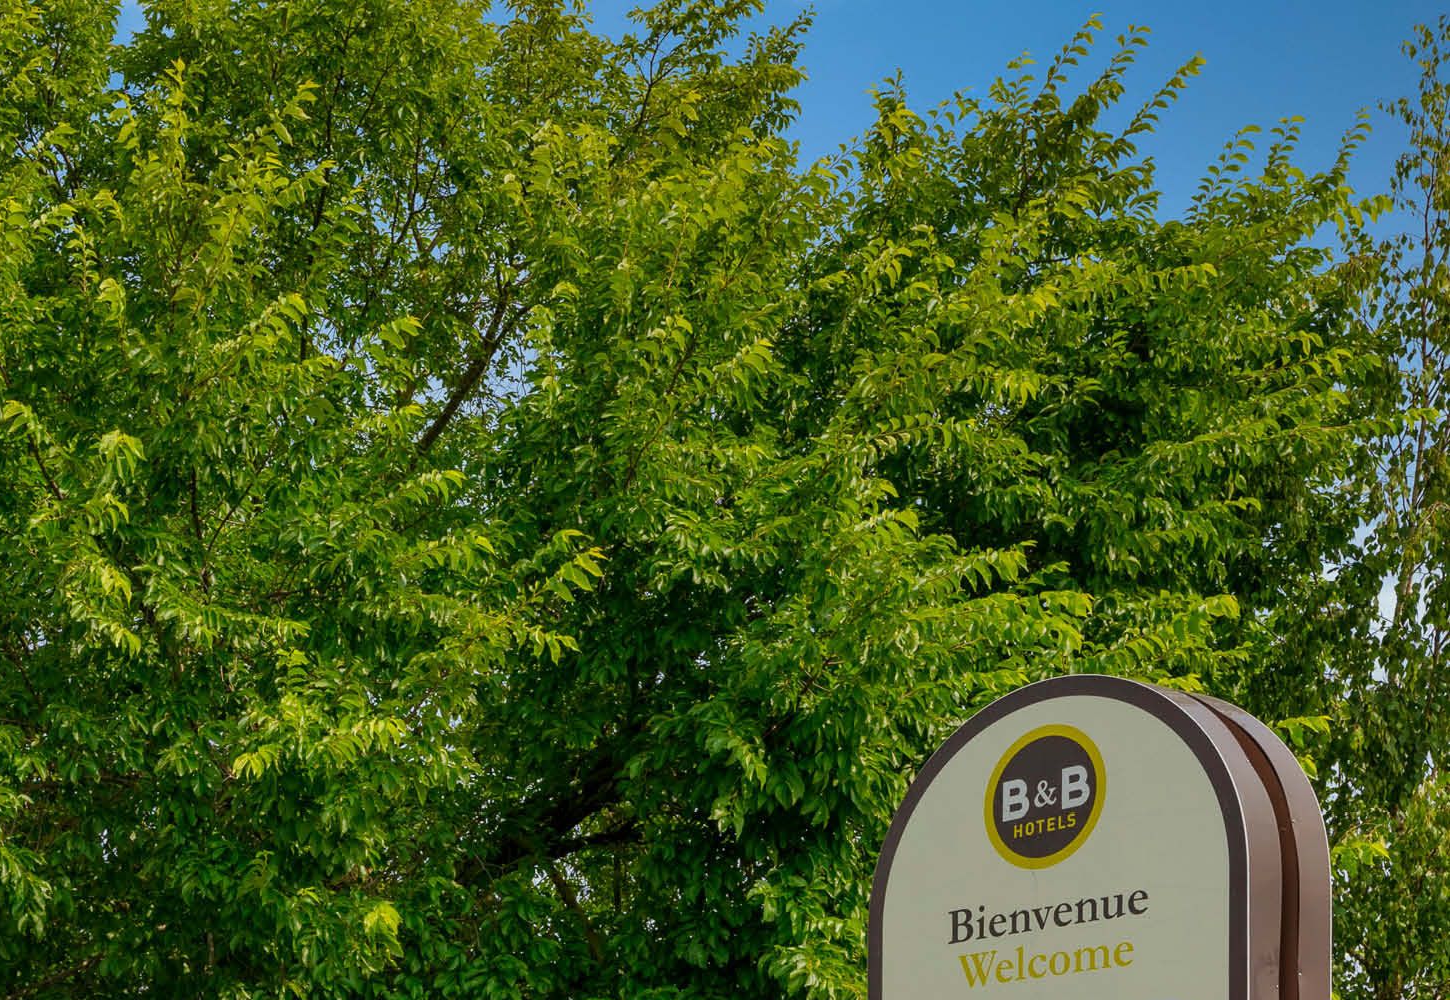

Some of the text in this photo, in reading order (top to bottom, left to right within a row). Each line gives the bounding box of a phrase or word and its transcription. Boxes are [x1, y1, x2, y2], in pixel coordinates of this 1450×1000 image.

[1002, 764, 1091, 823] B&B
[1013, 811, 1077, 839] HOTELS
[948, 889, 1149, 944] Bienvenue
[958, 940, 1135, 989] Welcome
